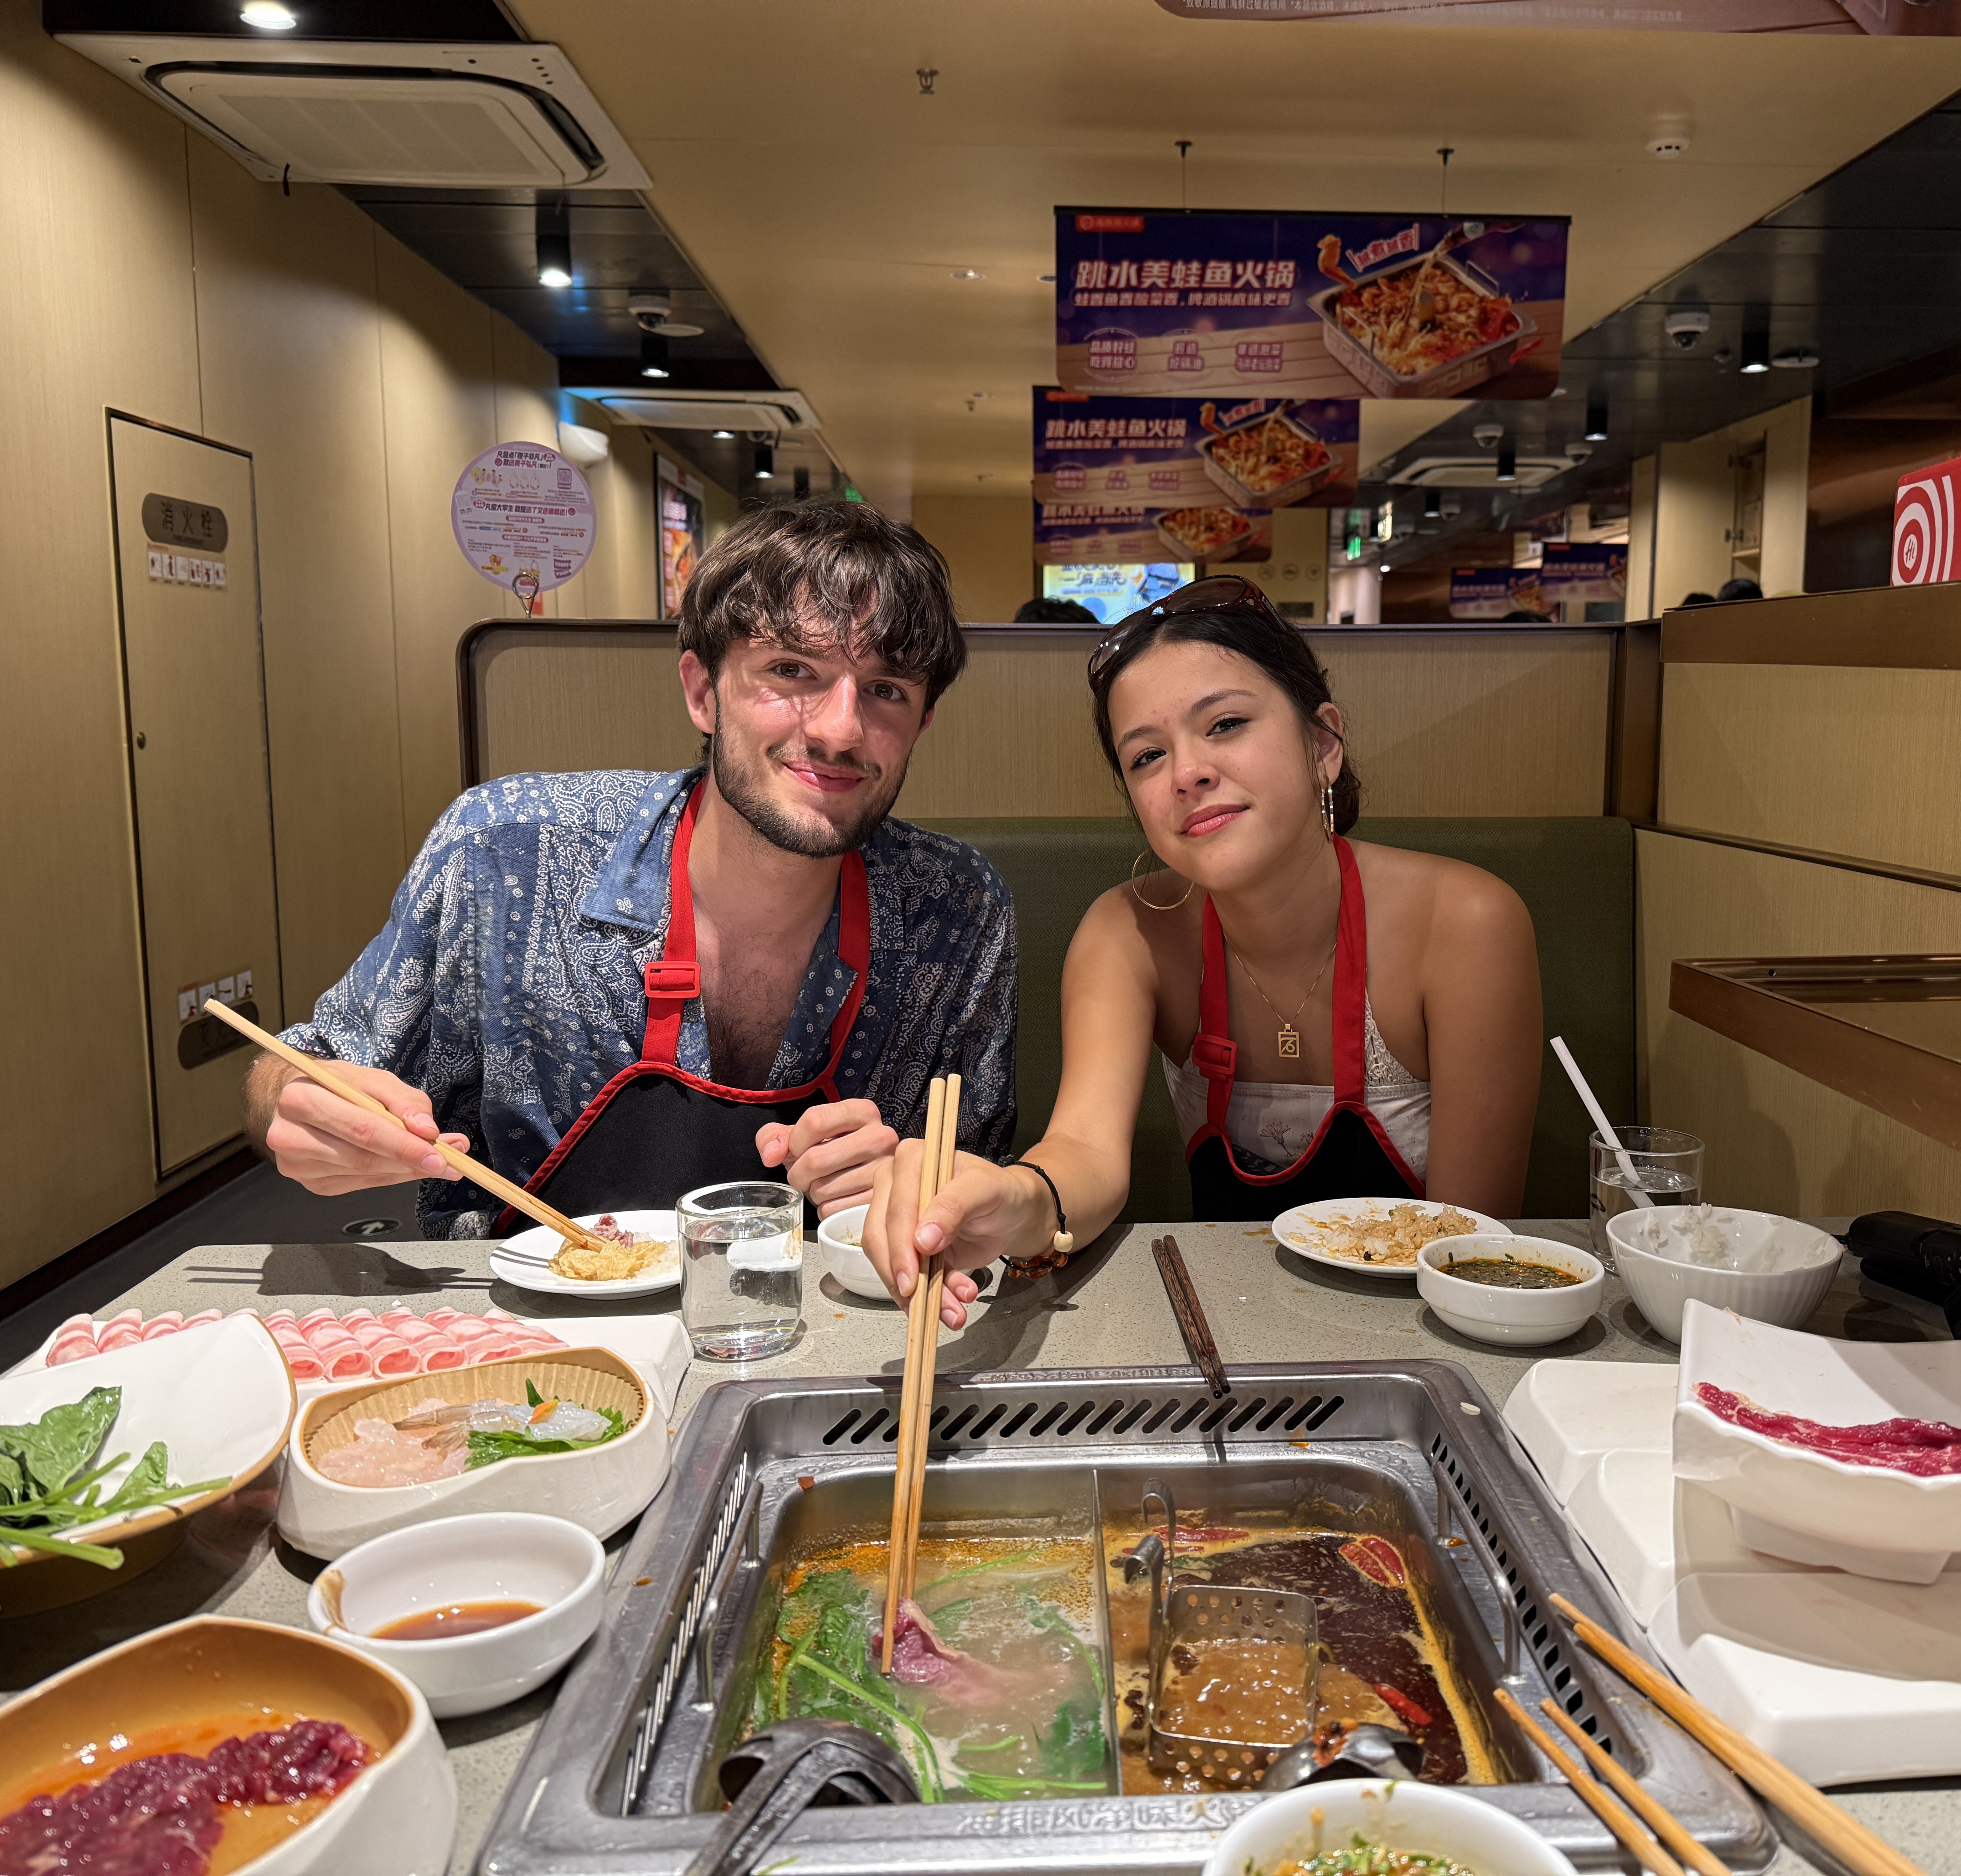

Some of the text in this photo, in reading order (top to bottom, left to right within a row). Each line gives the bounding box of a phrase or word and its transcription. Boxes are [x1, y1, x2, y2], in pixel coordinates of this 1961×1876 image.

[1075, 261, 1295, 289] 跳水美蛙鱼火锅
[1046, 419, 1187, 438] 跳水美蛙鱼火锅
